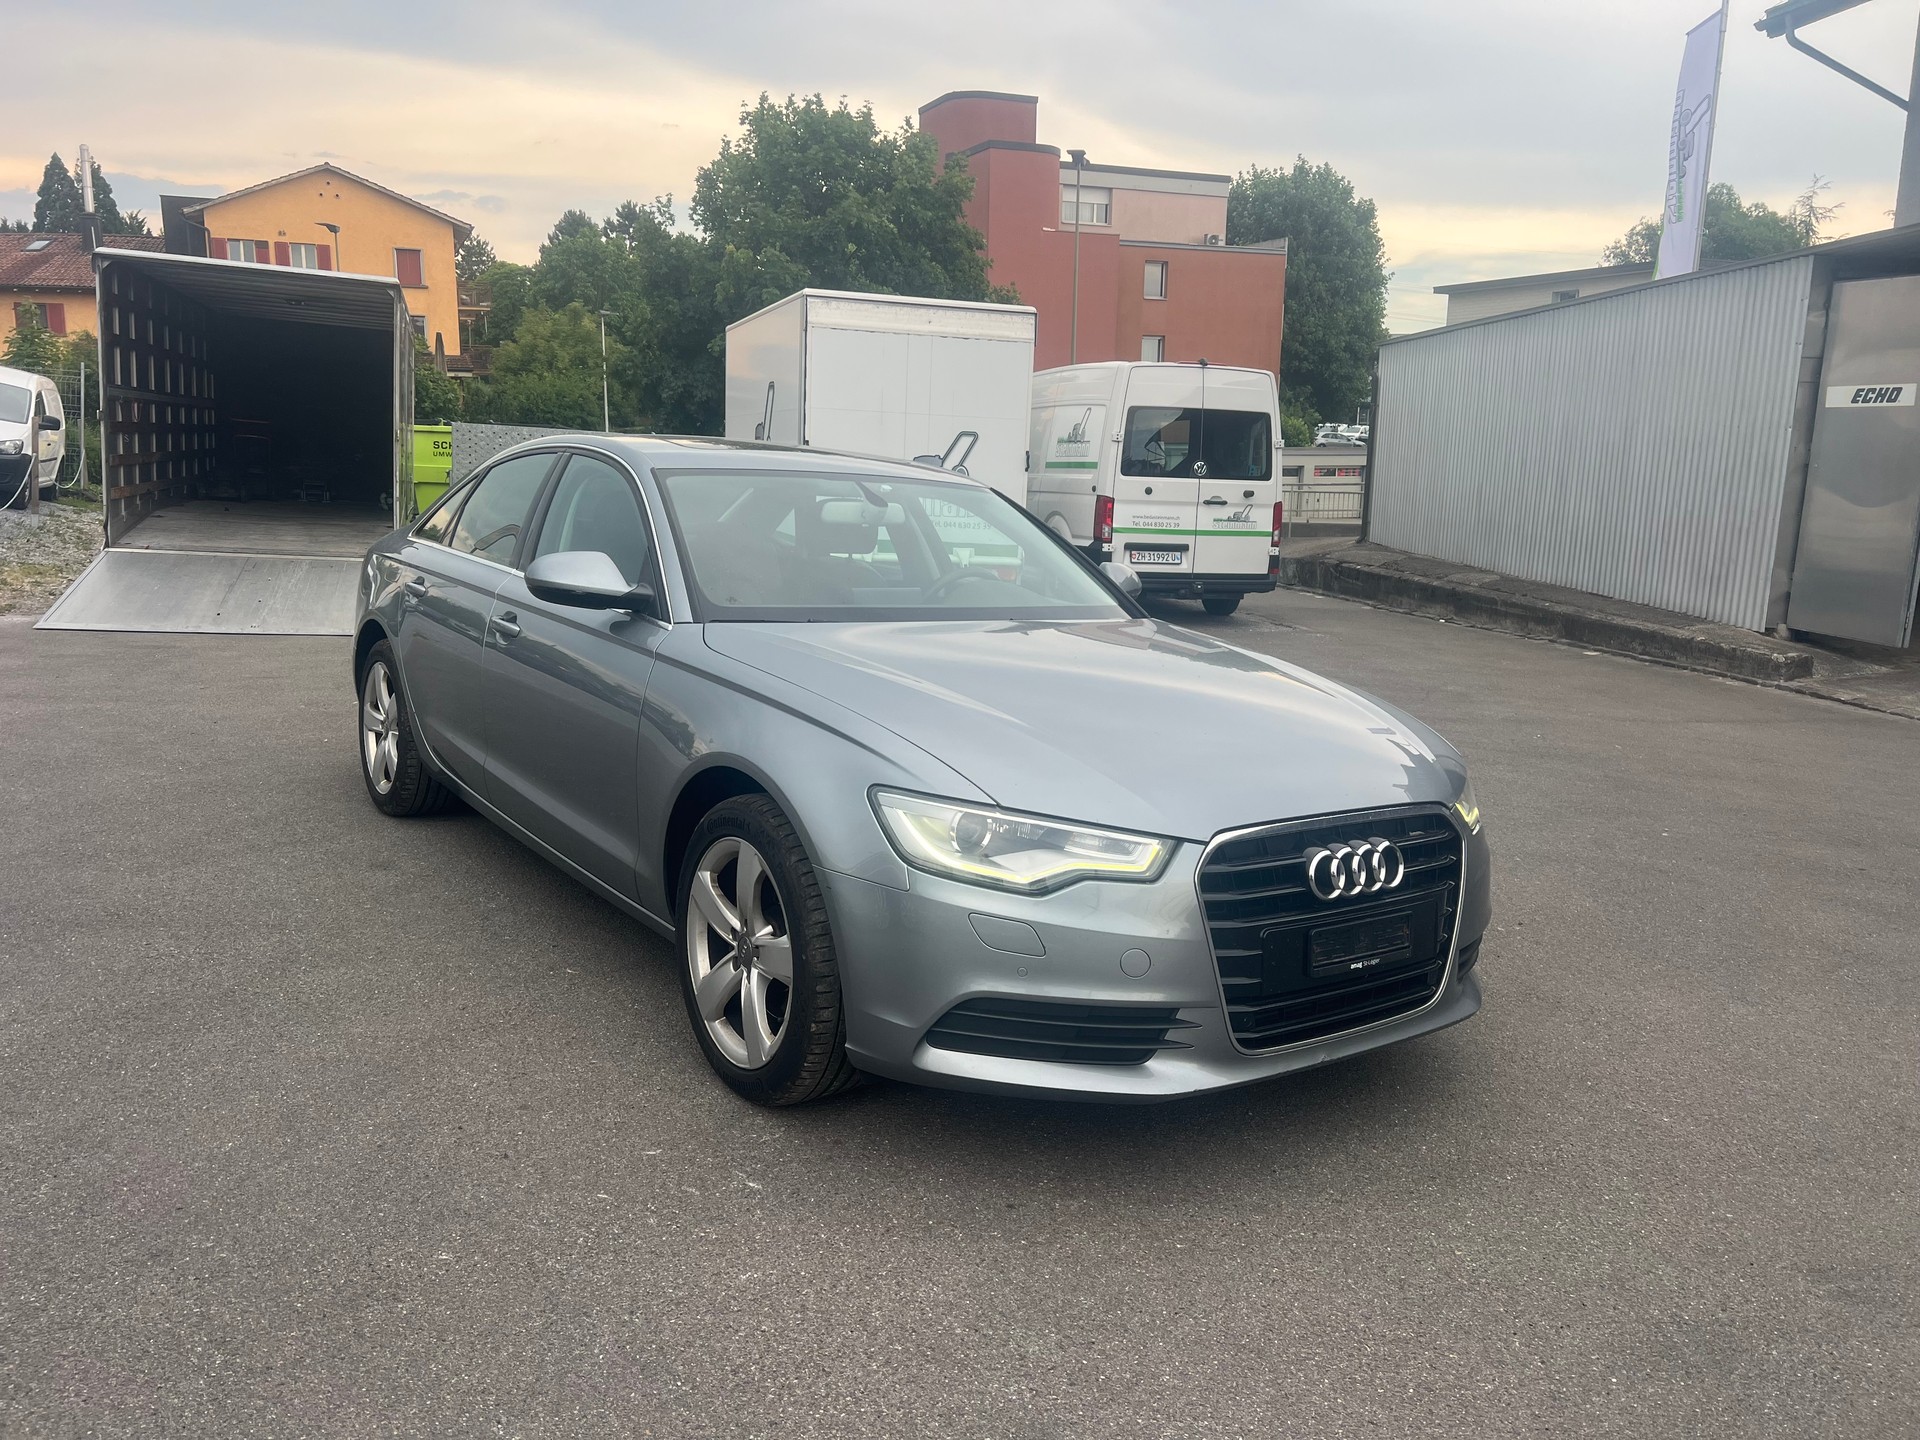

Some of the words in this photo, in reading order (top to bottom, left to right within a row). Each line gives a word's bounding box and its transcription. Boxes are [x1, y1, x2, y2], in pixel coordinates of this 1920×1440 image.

[1850, 386, 1903, 404] ECHO
[958, 521, 971, 529] 830
[706, 814, 746, 834] Continental
